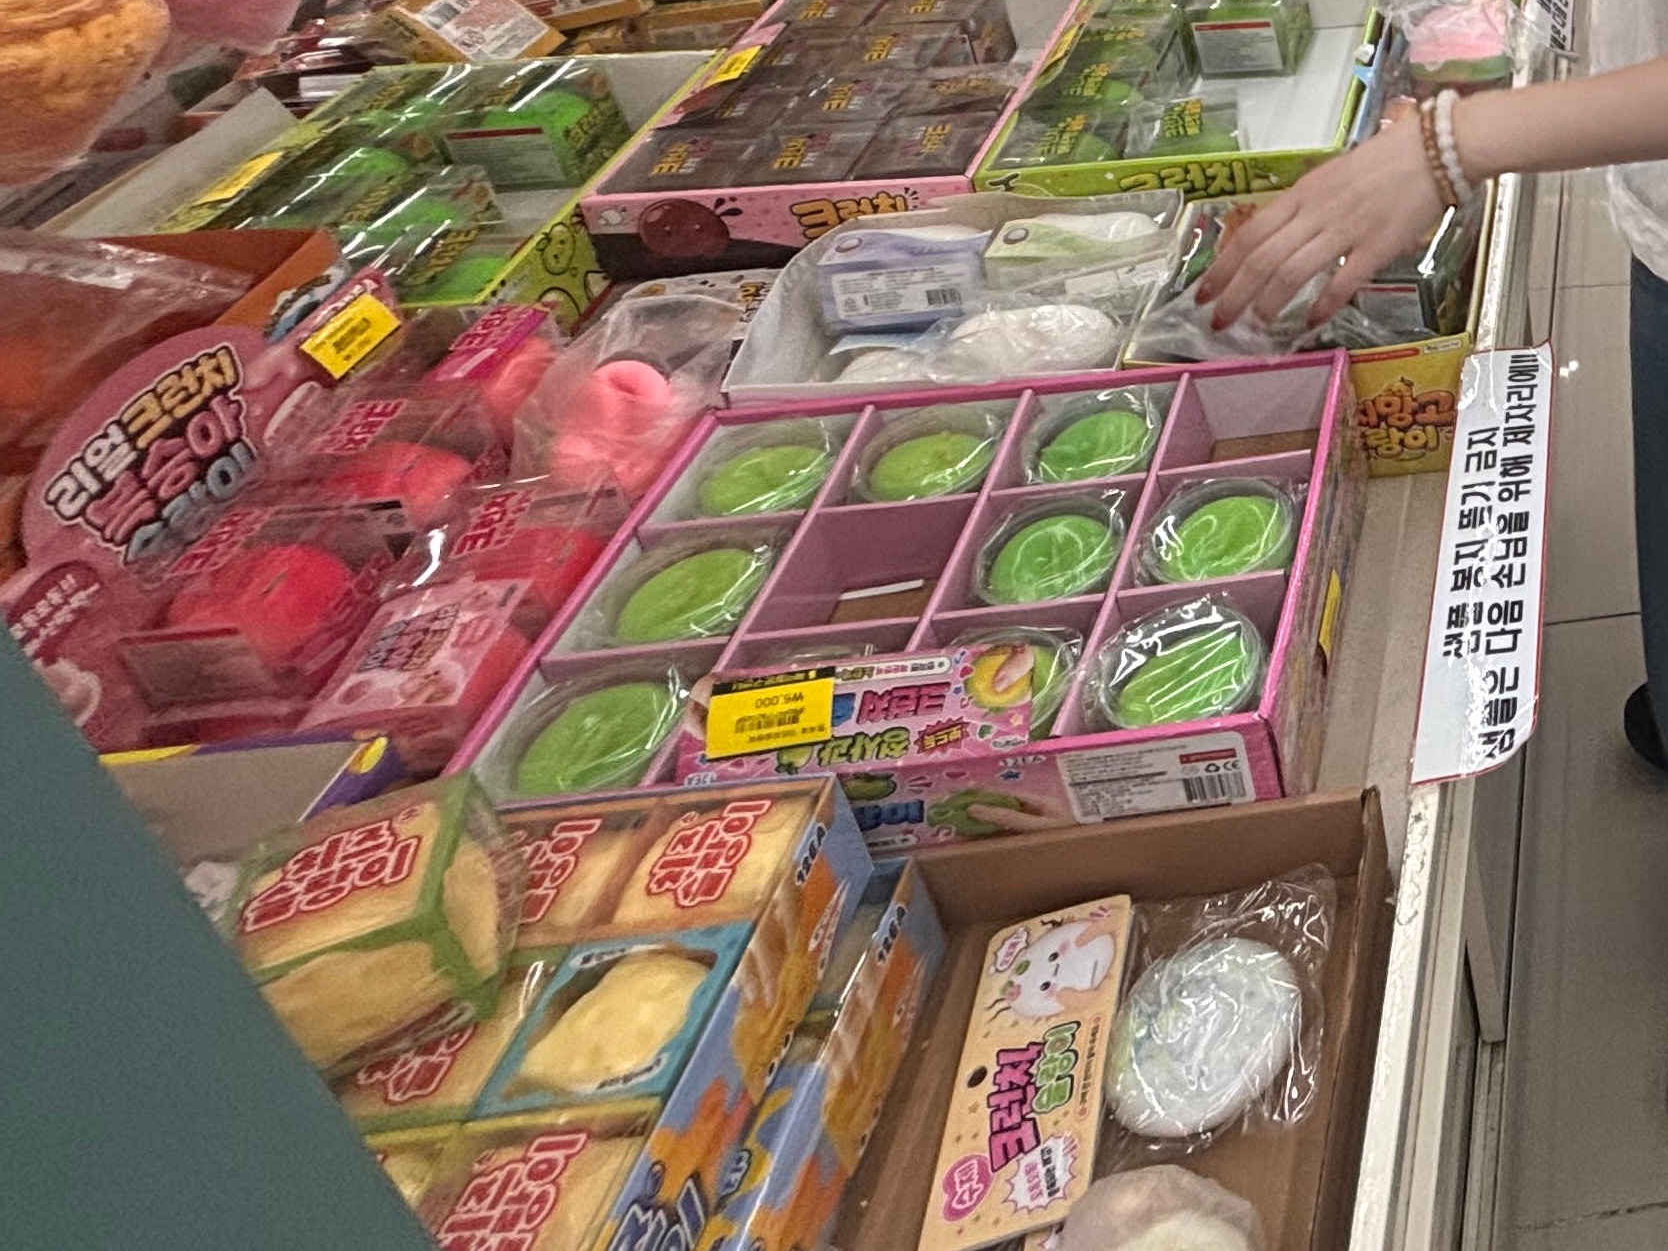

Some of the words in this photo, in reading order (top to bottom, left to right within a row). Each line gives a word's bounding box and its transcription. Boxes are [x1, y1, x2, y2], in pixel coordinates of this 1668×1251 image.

[1463, 425, 1501, 474] 금지
[1497, 452, 1535, 503] 위해
[1490, 510, 1531, 588] 손님을
[1485, 599, 1525, 656] 다음
[855, 681, 952, 726] 크런치
[816, 726, 912, 768] 청사과
[1032, 1020, 1082, 1114] 슬랑이
[987, 1041, 1046, 1174] 크런치
